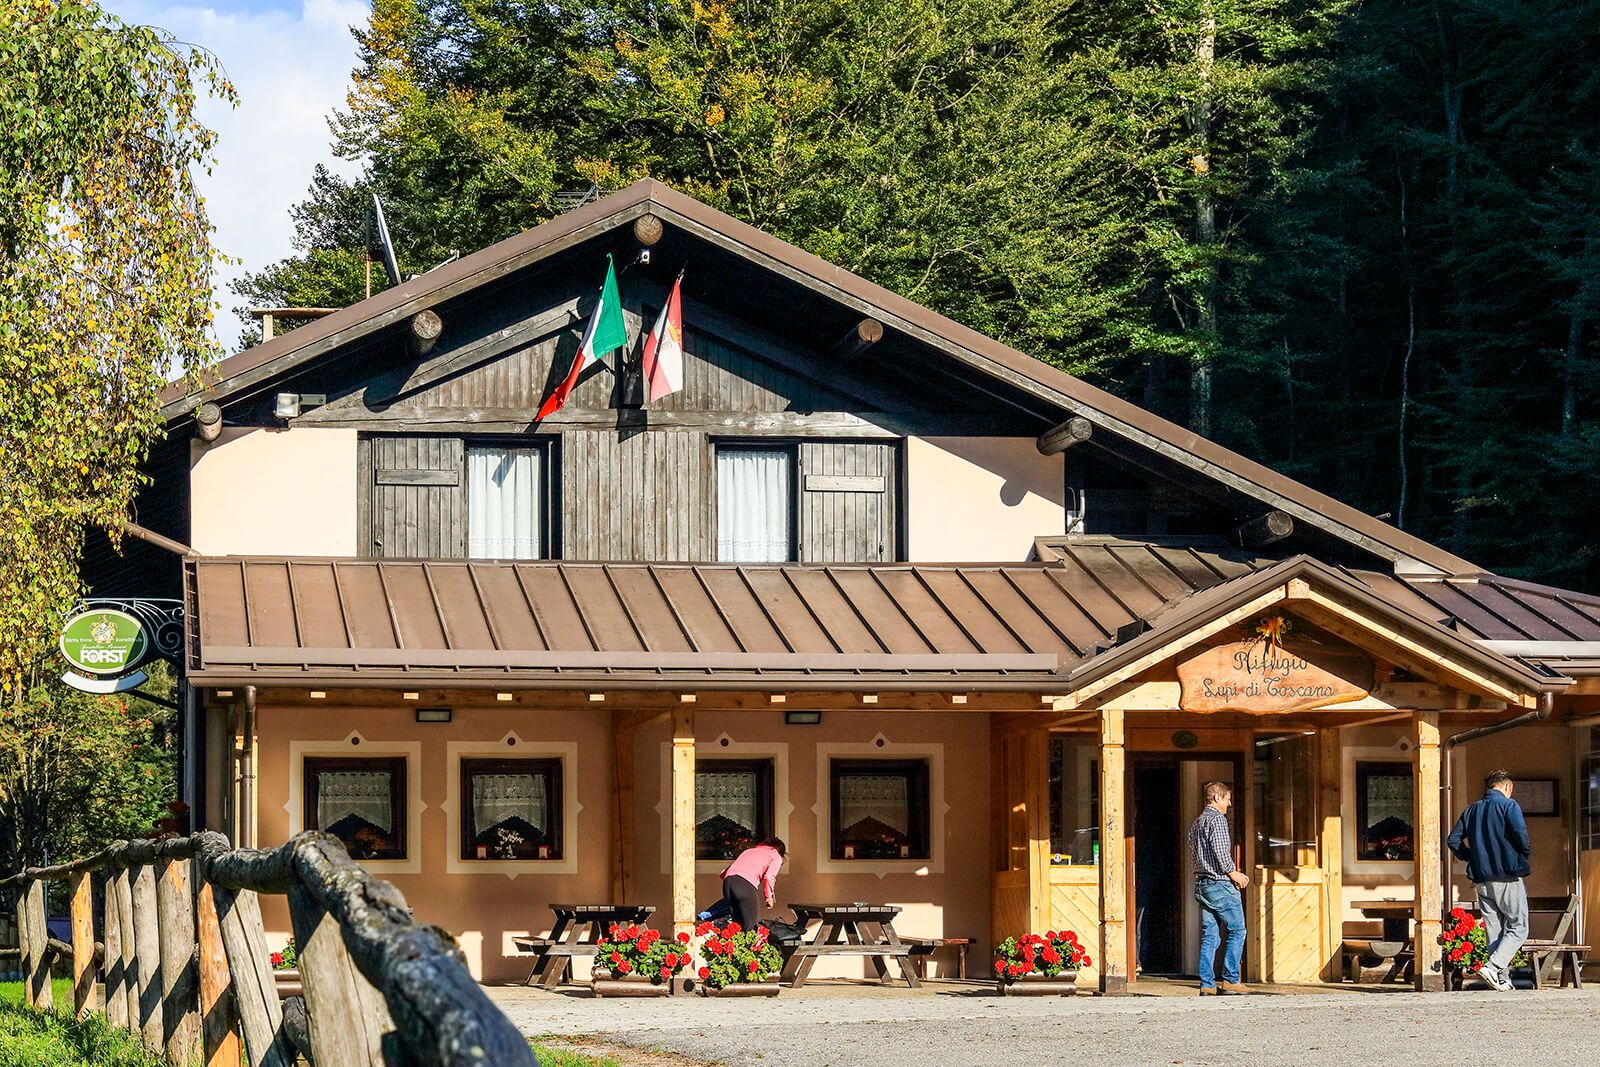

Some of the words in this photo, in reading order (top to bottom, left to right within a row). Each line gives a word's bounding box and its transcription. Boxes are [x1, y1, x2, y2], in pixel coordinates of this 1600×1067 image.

[80, 649, 127, 662] FORST
[1233, 651, 1308, 676] Rifugio
[1203, 678, 1239, 703] Lupi
[1245, 682, 1261, 697] di
[1263, 677, 1335, 697] Toscana
